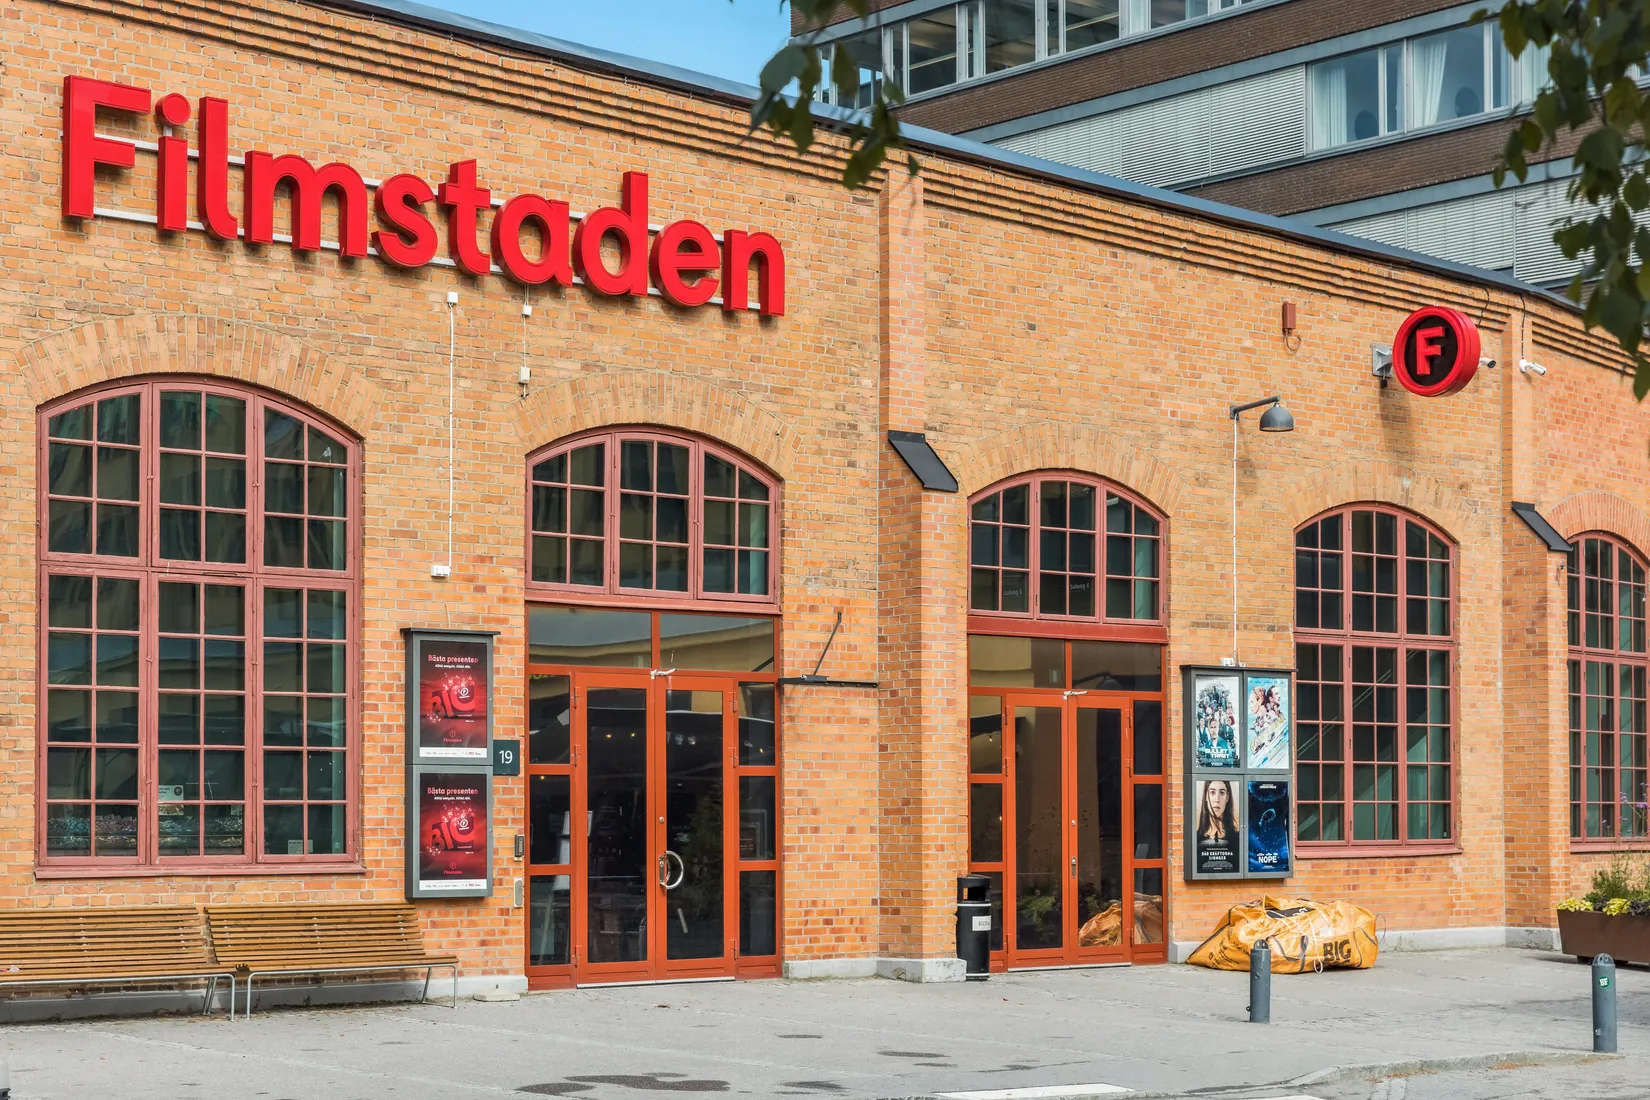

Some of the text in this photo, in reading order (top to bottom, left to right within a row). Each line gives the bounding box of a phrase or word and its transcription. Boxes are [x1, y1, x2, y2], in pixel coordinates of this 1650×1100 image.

[63, 75, 786, 317] Filmstaden
[1416, 326, 1446, 376] F
[428, 654, 478, 664] Bästa presenten
[499, 750, 513, 764] 19
[427, 786, 478, 796] Bästa presenten
[1258, 855, 1278, 864] NOPE
[1322, 938, 1352, 963] BIG
